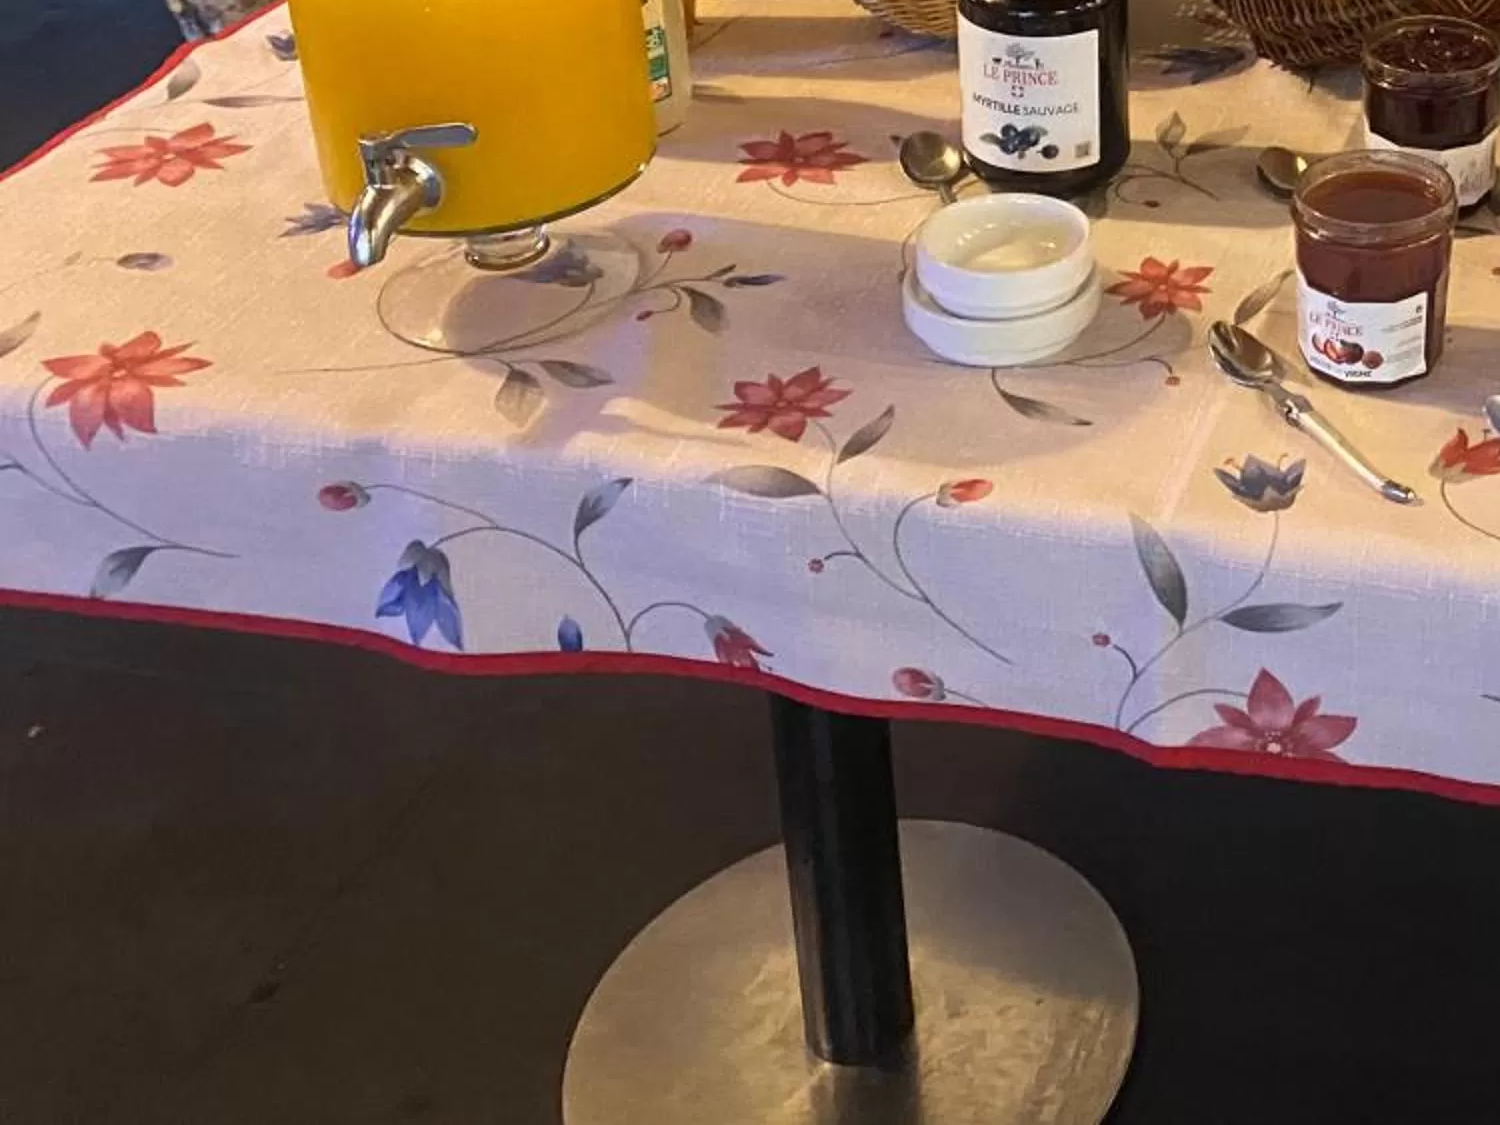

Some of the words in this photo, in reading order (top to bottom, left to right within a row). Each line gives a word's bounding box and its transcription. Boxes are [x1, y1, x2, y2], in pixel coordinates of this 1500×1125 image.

[983, 63, 999, 80] LE
[1003, 68, 1059, 86] PRINCE
[972, 91, 1022, 116] MYRTILLE
[1021, 102, 1080, 116] SAUVAGE
